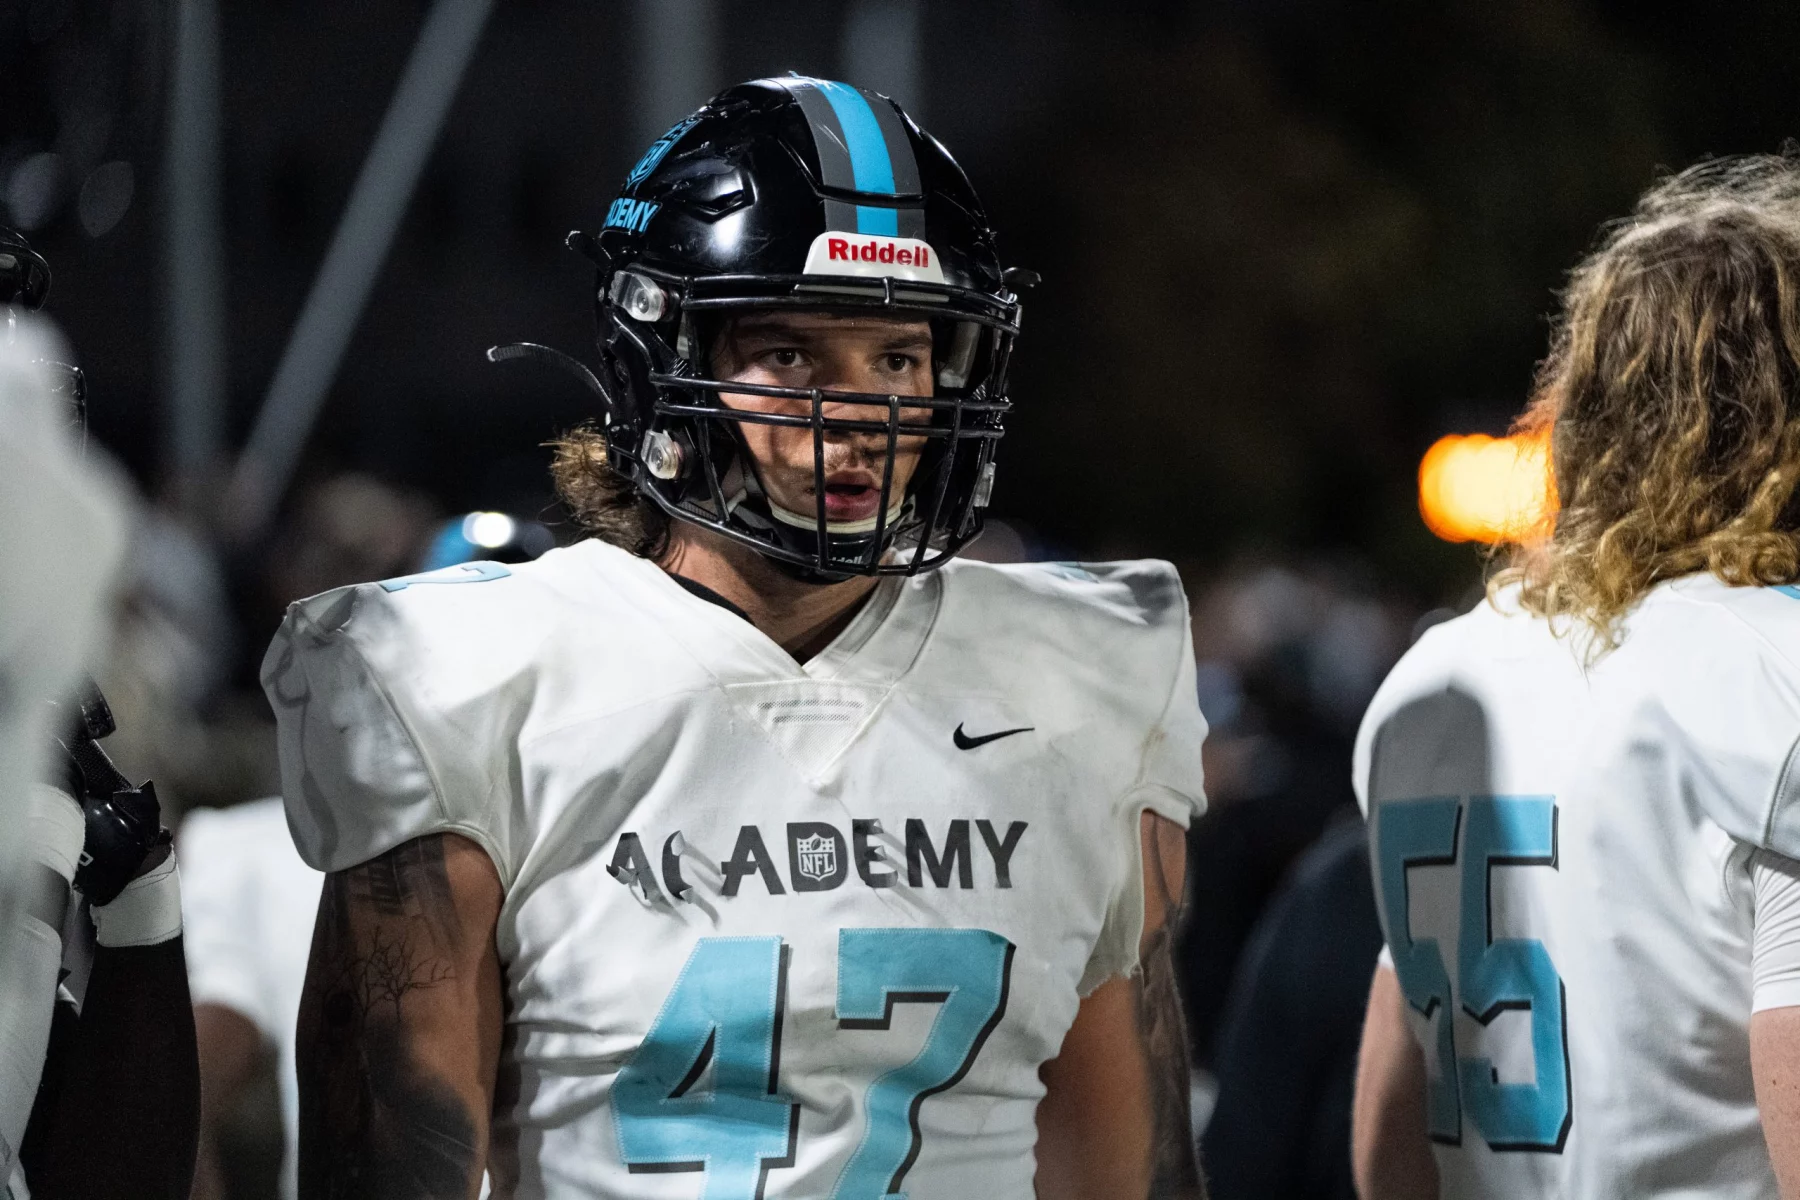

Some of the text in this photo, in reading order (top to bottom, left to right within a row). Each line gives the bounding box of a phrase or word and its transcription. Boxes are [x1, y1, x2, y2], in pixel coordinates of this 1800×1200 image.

[828, 238, 929, 268] Riddell
[605, 818, 1029, 902] ACADEMY
[801, 853, 834, 876] NFL
[1378, 795, 1573, 1155] 55
[609, 927, 1017, 1200] 47
